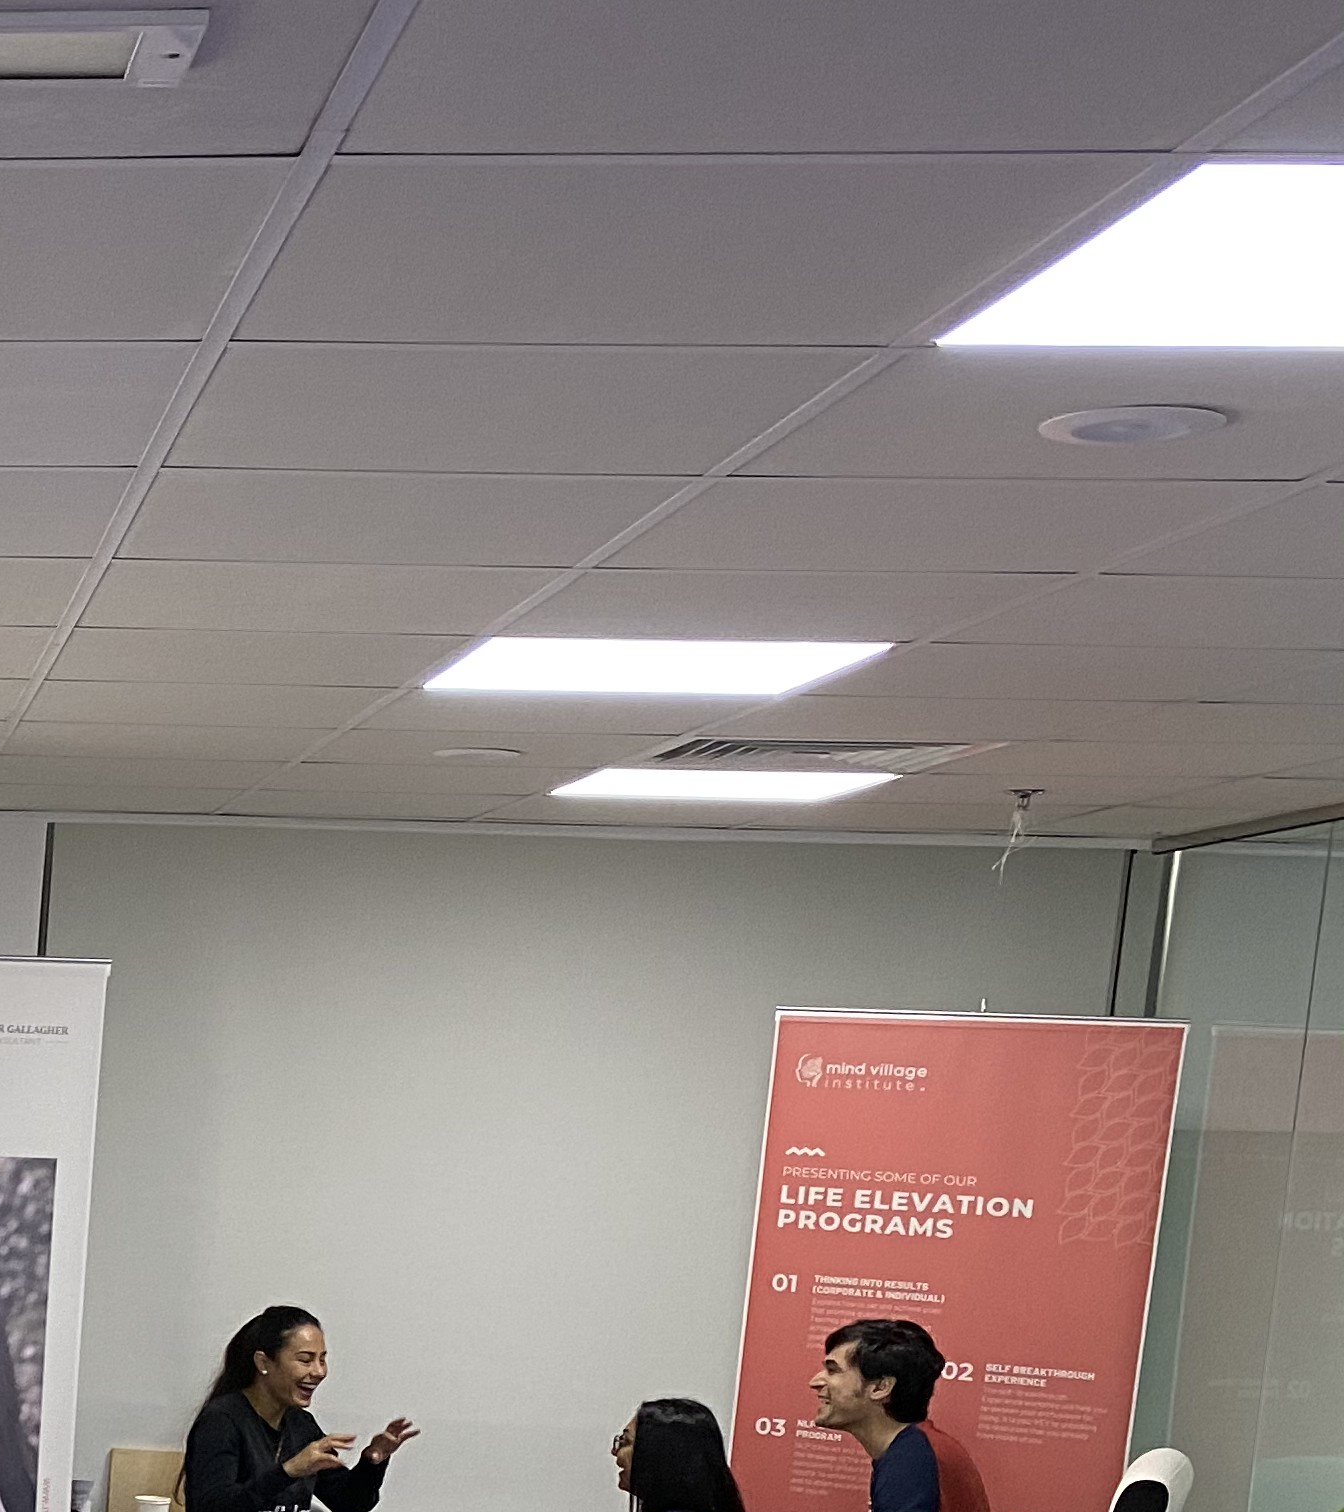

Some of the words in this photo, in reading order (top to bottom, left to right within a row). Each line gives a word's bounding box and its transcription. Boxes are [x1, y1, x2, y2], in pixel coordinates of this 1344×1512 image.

[7, 1023, 69, 1036] GALLAGHER
[826, 1062, 866, 1075] mind
[870, 1063, 928, 1080] village
[783, 1166, 872, 1182] PRESENTING
[874, 1171, 917, 1184] SOME
[920, 1173, 943, 1185] OF
[943, 1174, 978, 1187] OUR
[779, 1184, 844, 1207] LIFE
[853, 1188, 1034, 1219] ELEVATION
[777, 1209, 954, 1239] PROGRAMS
[771, 1273, 798, 1293] 01
[812, 1285, 874, 1298] (CORPORATE
[814, 1274, 859, 1286] THINKING
[860, 1277, 883, 1288] INTO
[884, 1280, 929, 1291] RESULTS
[941, 1361, 974, 1382] 02
[984, 1374, 1047, 1387] EXPERIENCE
[985, 1363, 1011, 1374] SELF
[1012, 1366, 1095, 1381] BREAKTHROUGH
[755, 1417, 787, 1437] 03
[795, 1429, 842, 1441] PROGRAM
